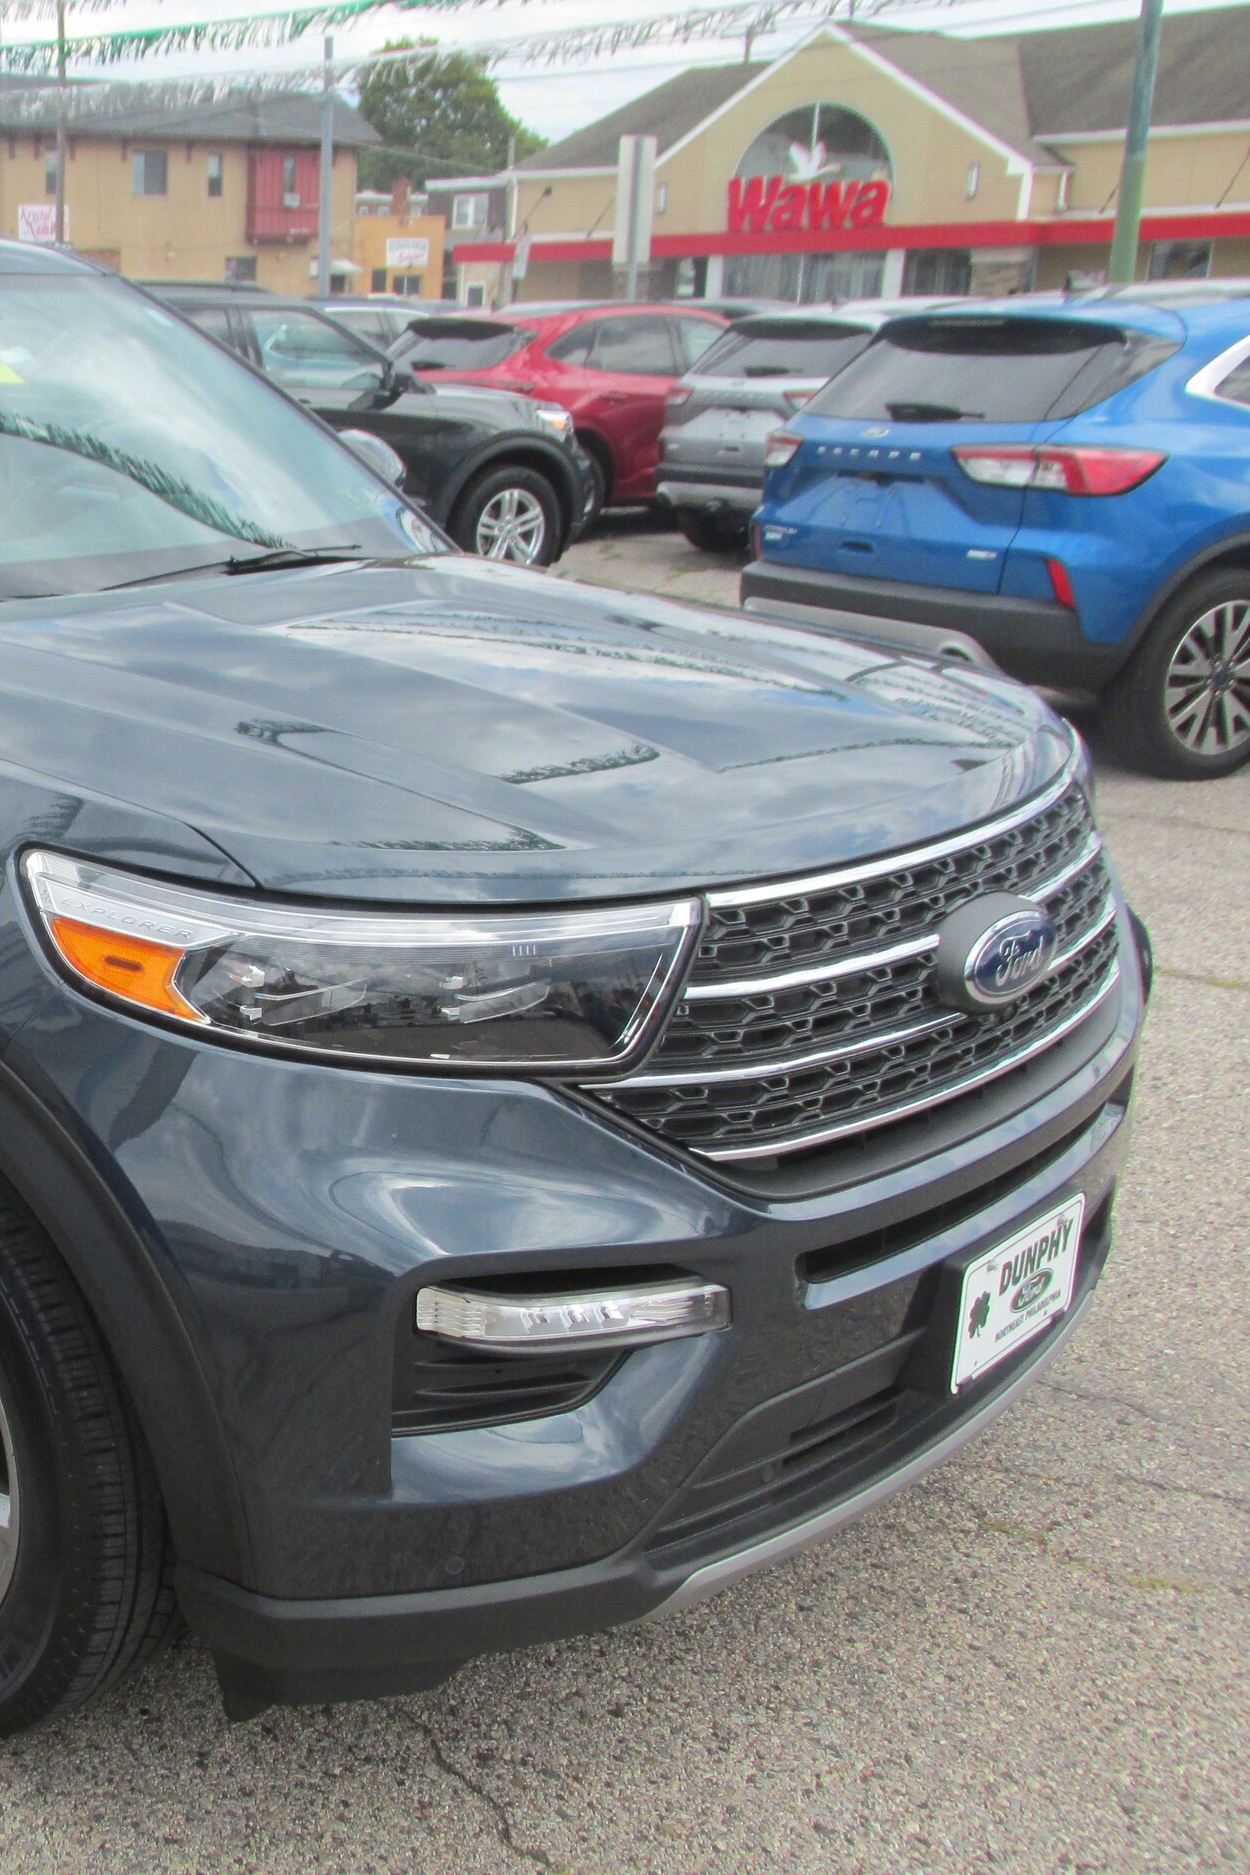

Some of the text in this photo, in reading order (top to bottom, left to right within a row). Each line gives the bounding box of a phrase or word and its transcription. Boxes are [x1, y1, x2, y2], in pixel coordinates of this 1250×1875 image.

[728, 174, 889, 232] Wawa
[61, 898, 195, 939] EXPLORER
[995, 929, 1045, 987] Ford
[998, 1217, 1074, 1296] DUNPHY
